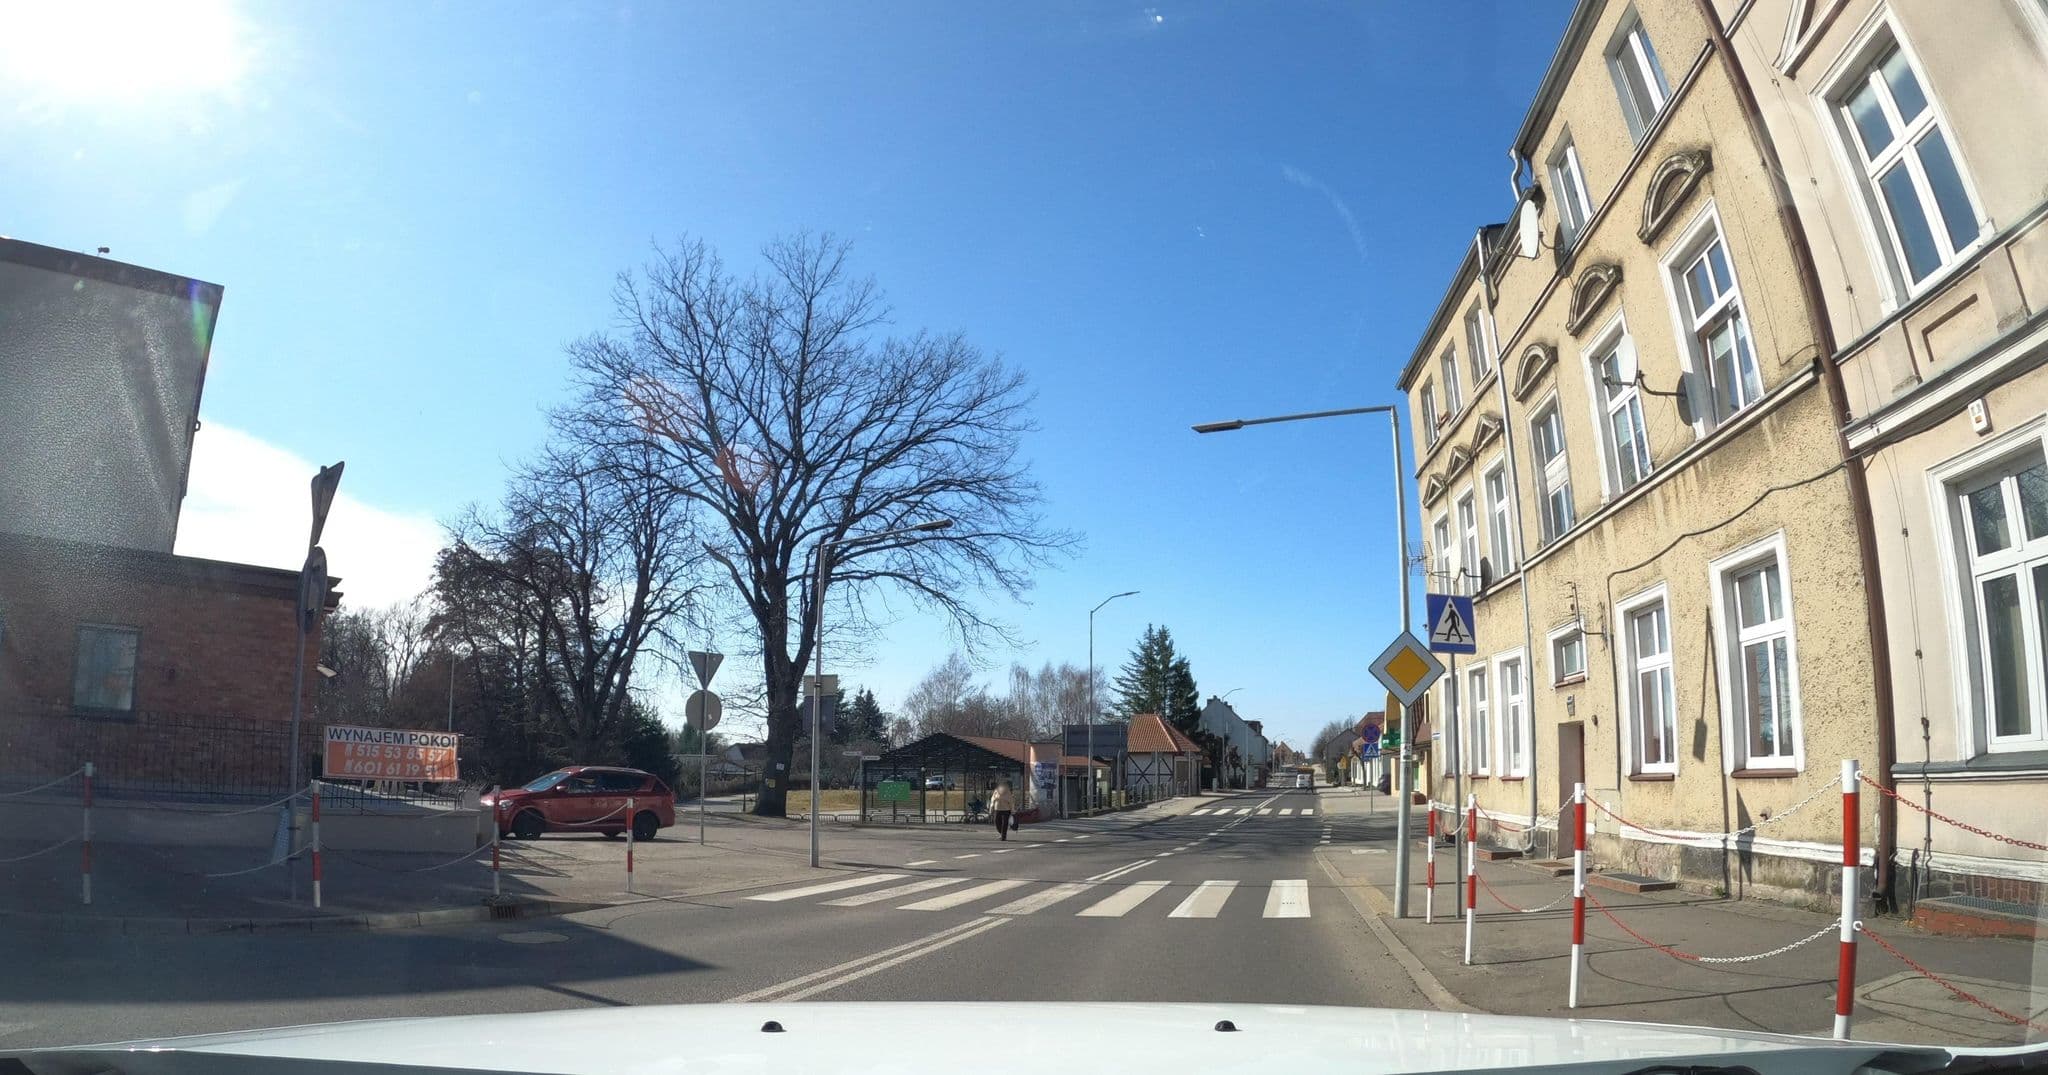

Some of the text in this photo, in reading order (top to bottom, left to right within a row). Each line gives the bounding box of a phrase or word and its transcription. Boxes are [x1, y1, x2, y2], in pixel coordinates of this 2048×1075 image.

[328, 727, 456, 747] WYNAJEM POKOI
[357, 745, 380, 757] 515
